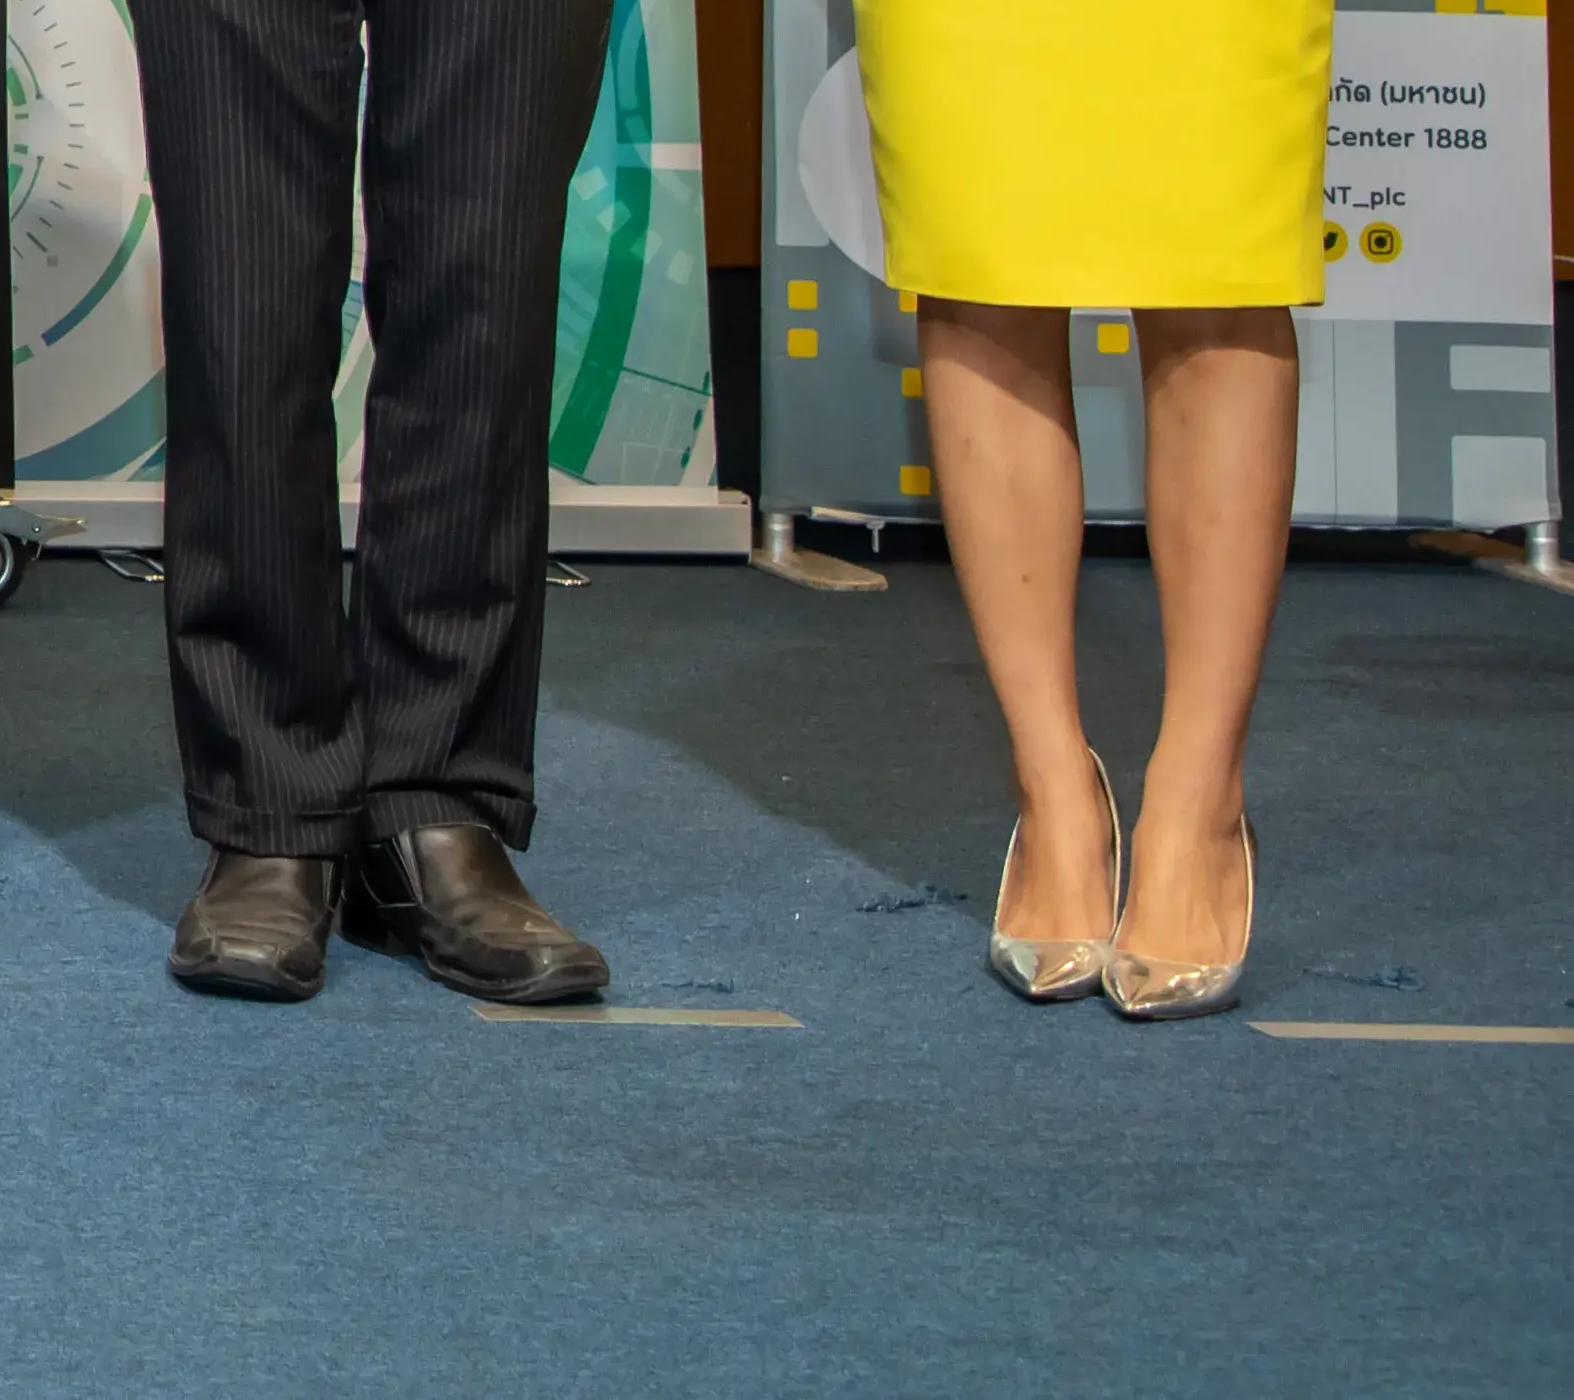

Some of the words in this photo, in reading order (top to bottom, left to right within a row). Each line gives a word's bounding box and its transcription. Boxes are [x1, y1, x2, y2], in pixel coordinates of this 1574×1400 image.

[1381, 80, 1486, 109] (มหาชน)
[1326, 126, 1415, 147] Center
[1424, 128, 1488, 150] 1888
